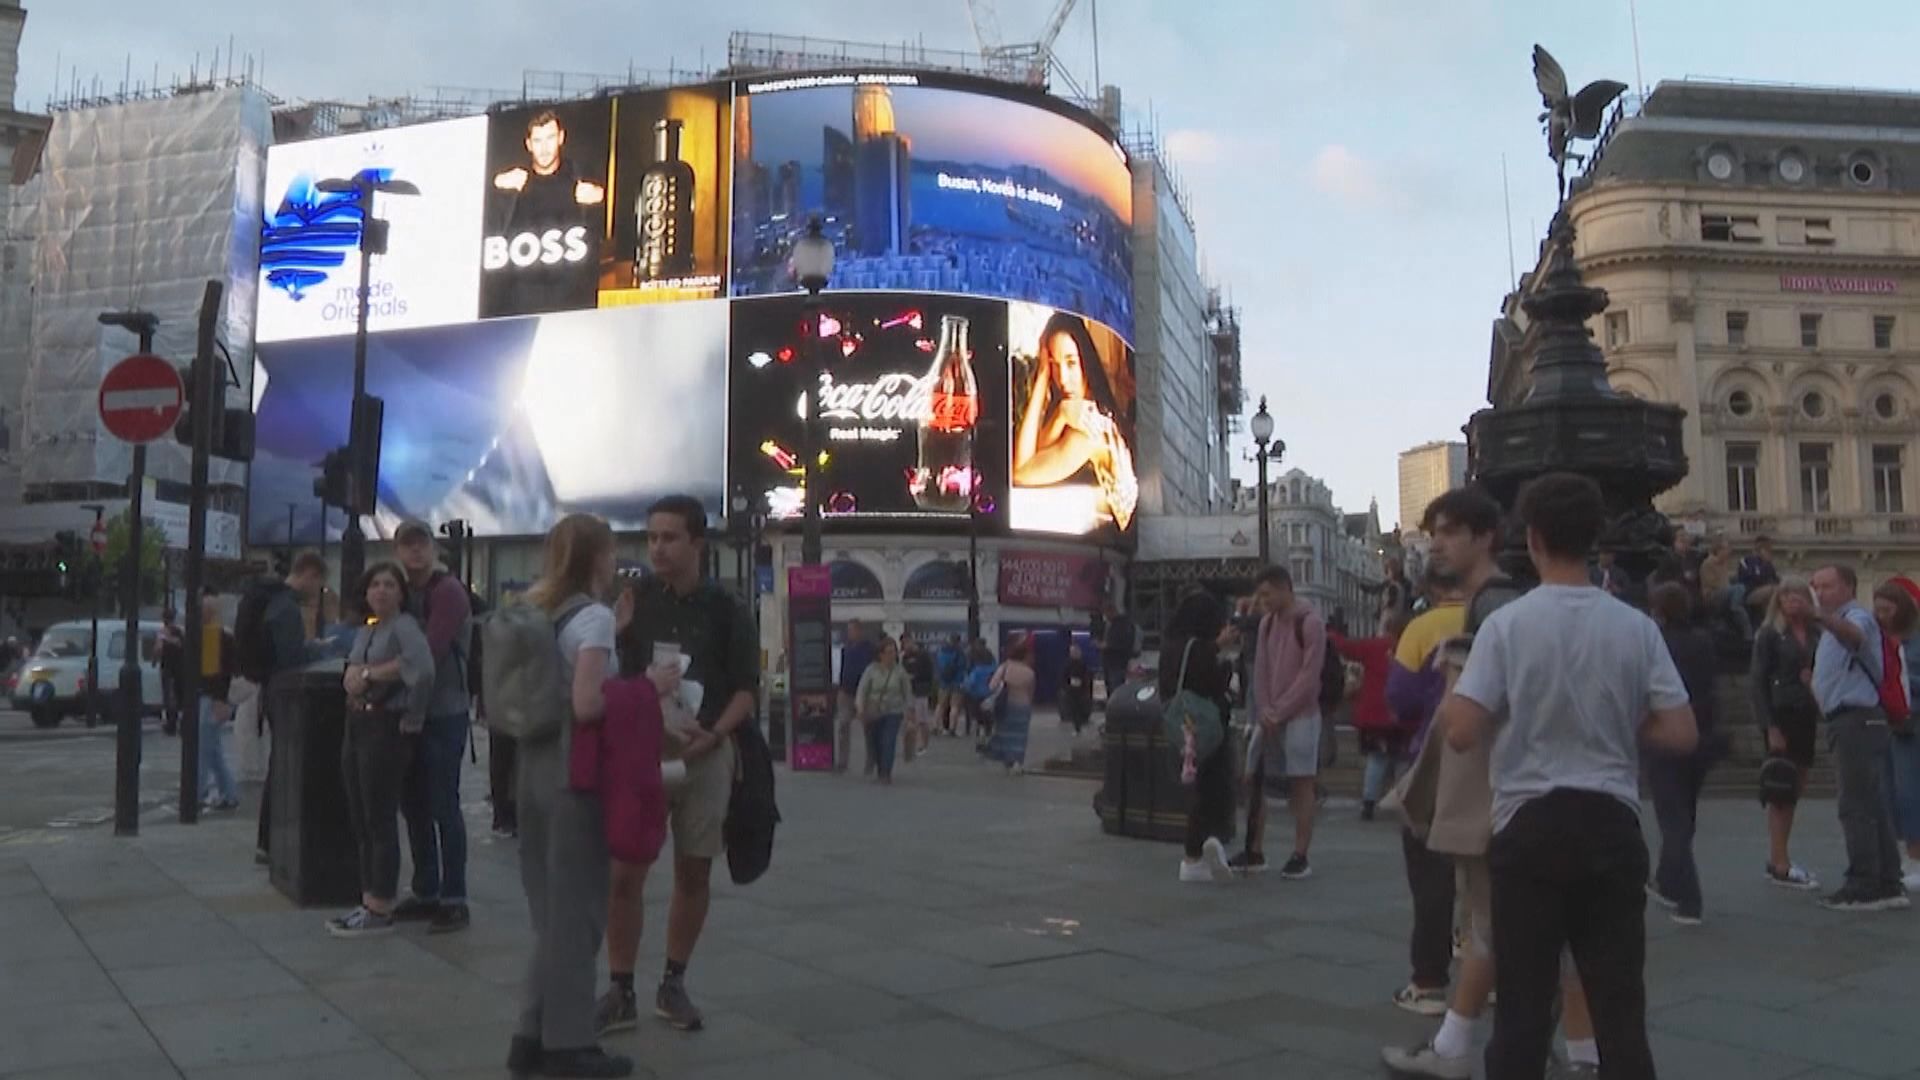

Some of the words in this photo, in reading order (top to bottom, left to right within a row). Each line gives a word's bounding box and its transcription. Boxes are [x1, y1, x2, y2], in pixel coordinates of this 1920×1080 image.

[938, 173, 980, 193] Busan,
[982, 178, 1015, 197] Korea
[1017, 184, 1026, 199] is
[1027, 187, 1062, 211] already
[483, 226, 588, 270] BOSS
[322, 297, 408, 323] Orignals
[830, 428, 858, 440] Real
